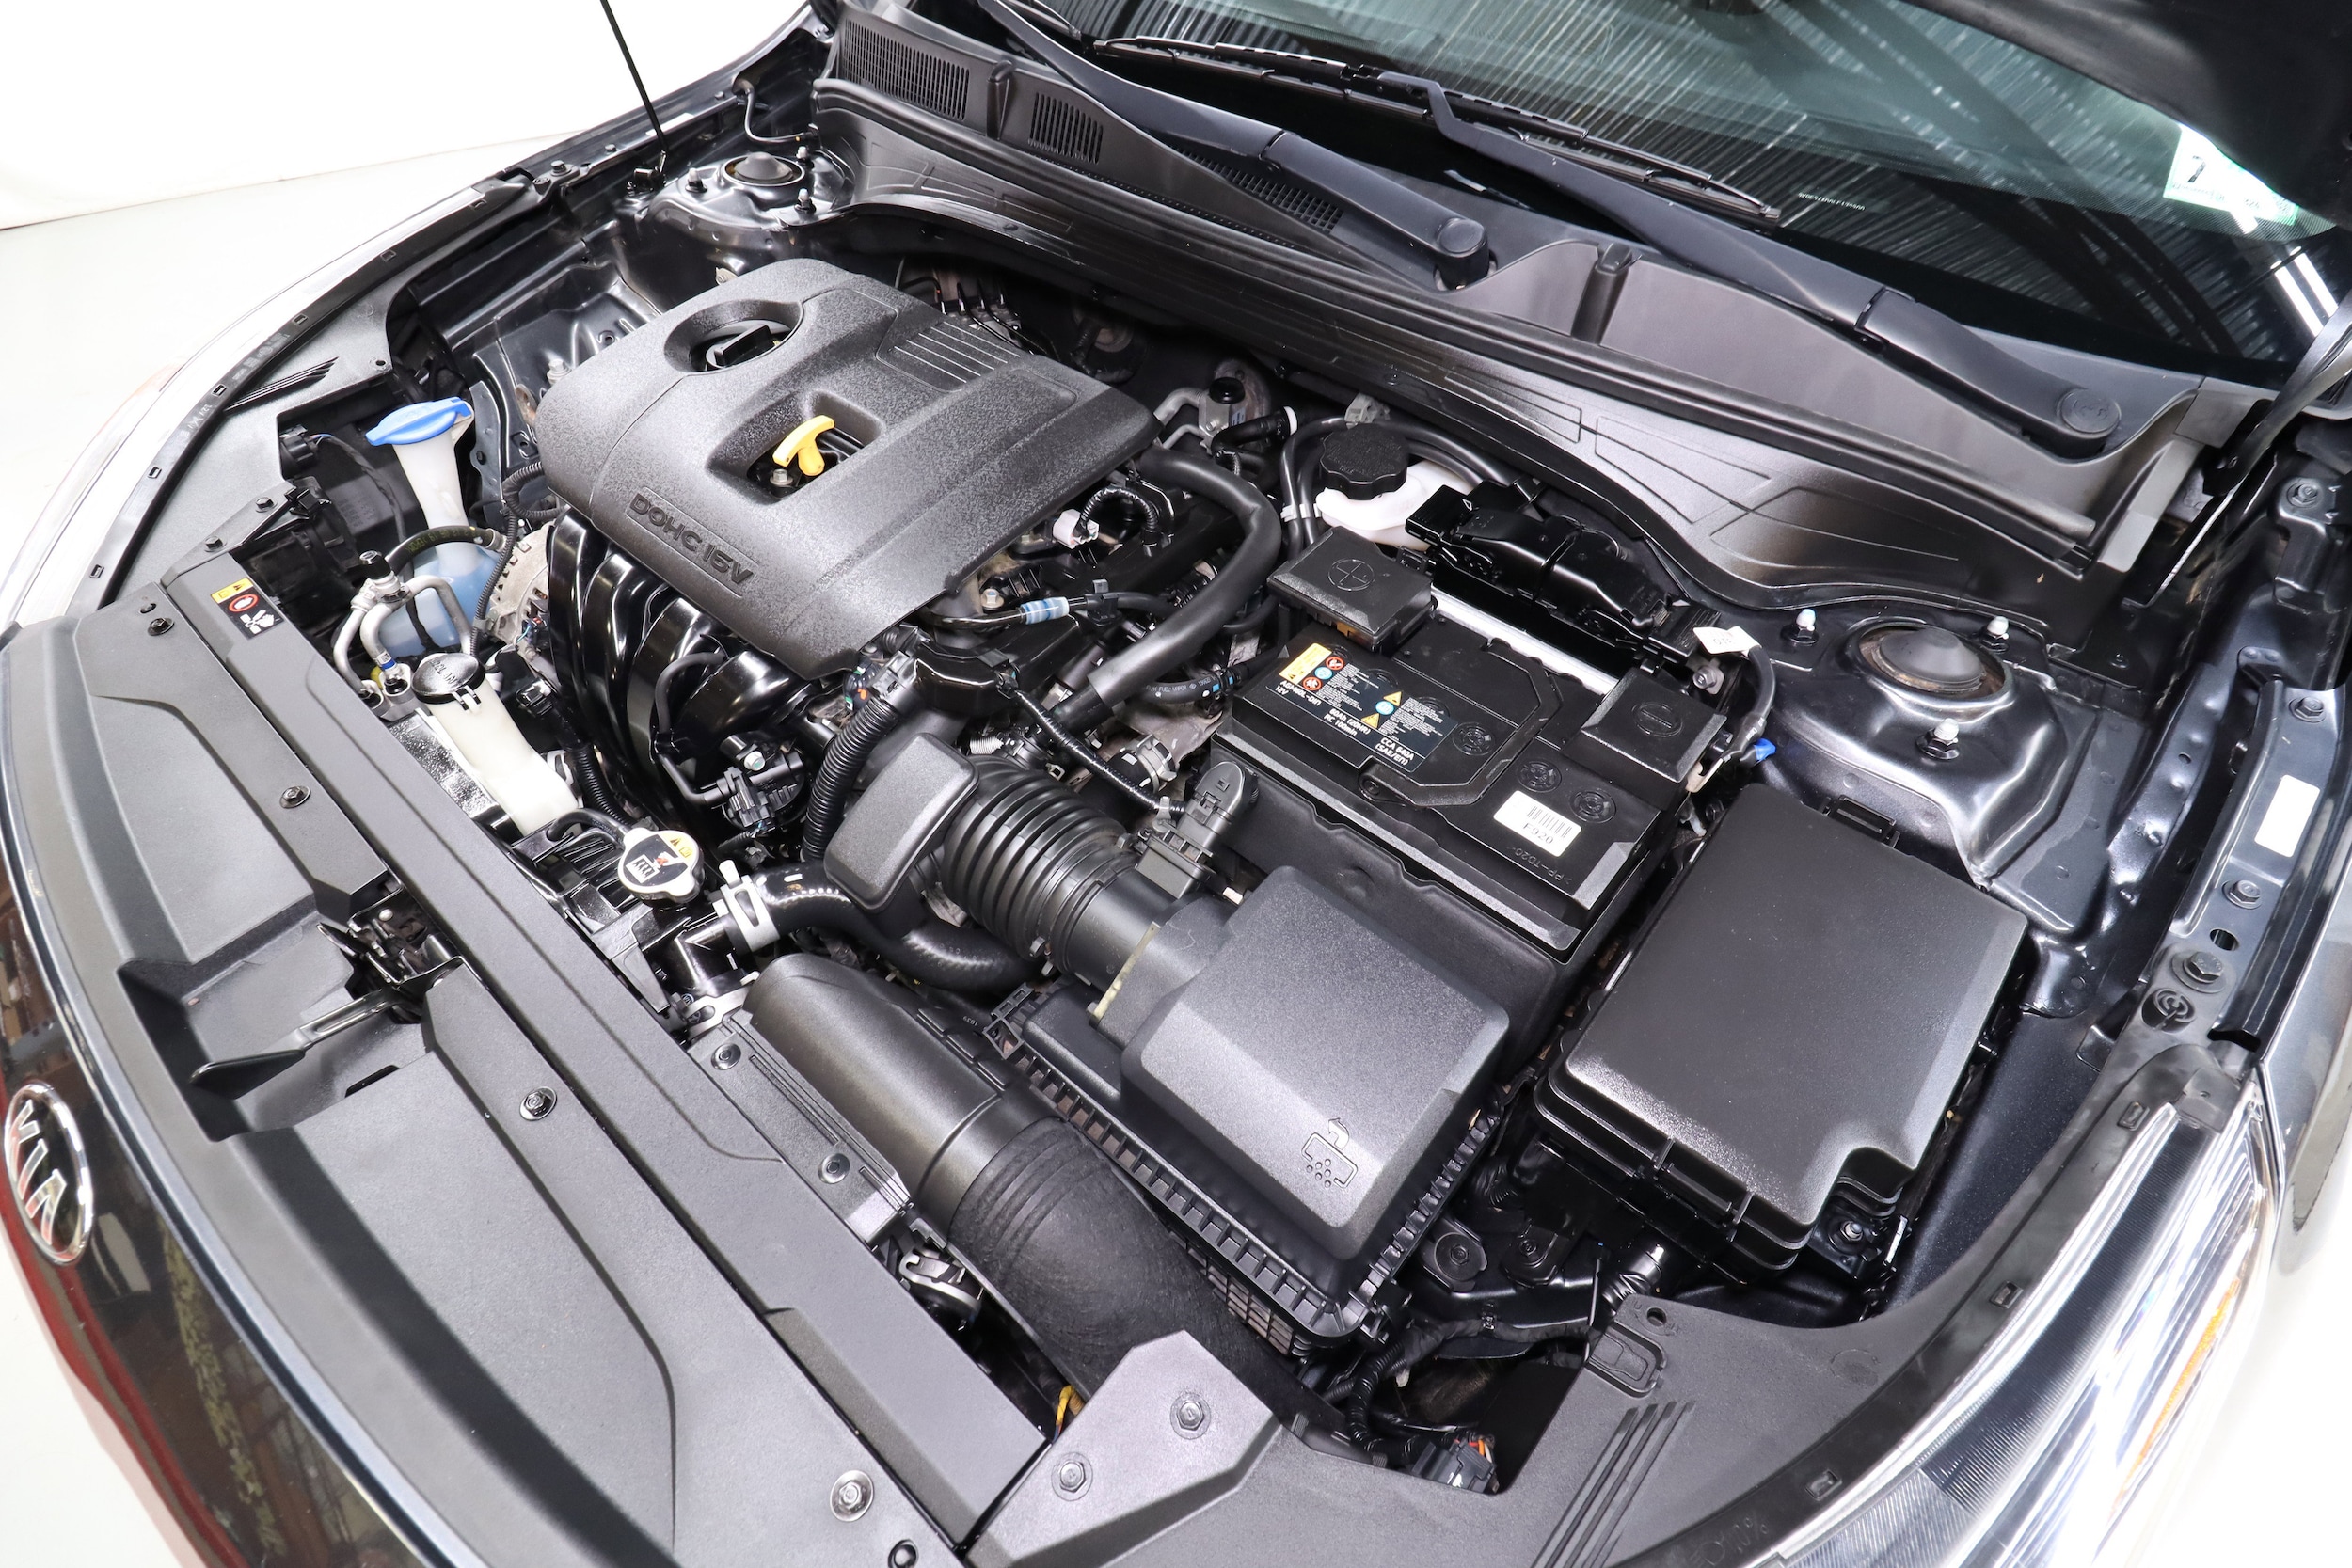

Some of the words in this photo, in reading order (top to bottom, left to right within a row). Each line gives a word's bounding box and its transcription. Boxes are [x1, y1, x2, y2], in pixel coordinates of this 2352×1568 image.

[629, 493, 702, 552] DOHC
[1275, 685, 1289, 696] 12V
[1323, 714, 1336, 725] RC
[1335, 721, 1359, 736] 100min
[1329, 708, 1347, 722] 60Ah
[1347, 718, 1372, 736] (20HR)
[1380, 736, 1396, 750] CCA
[1395, 745, 1415, 761] 640A
[1522, 822, 1554, 845] F920
